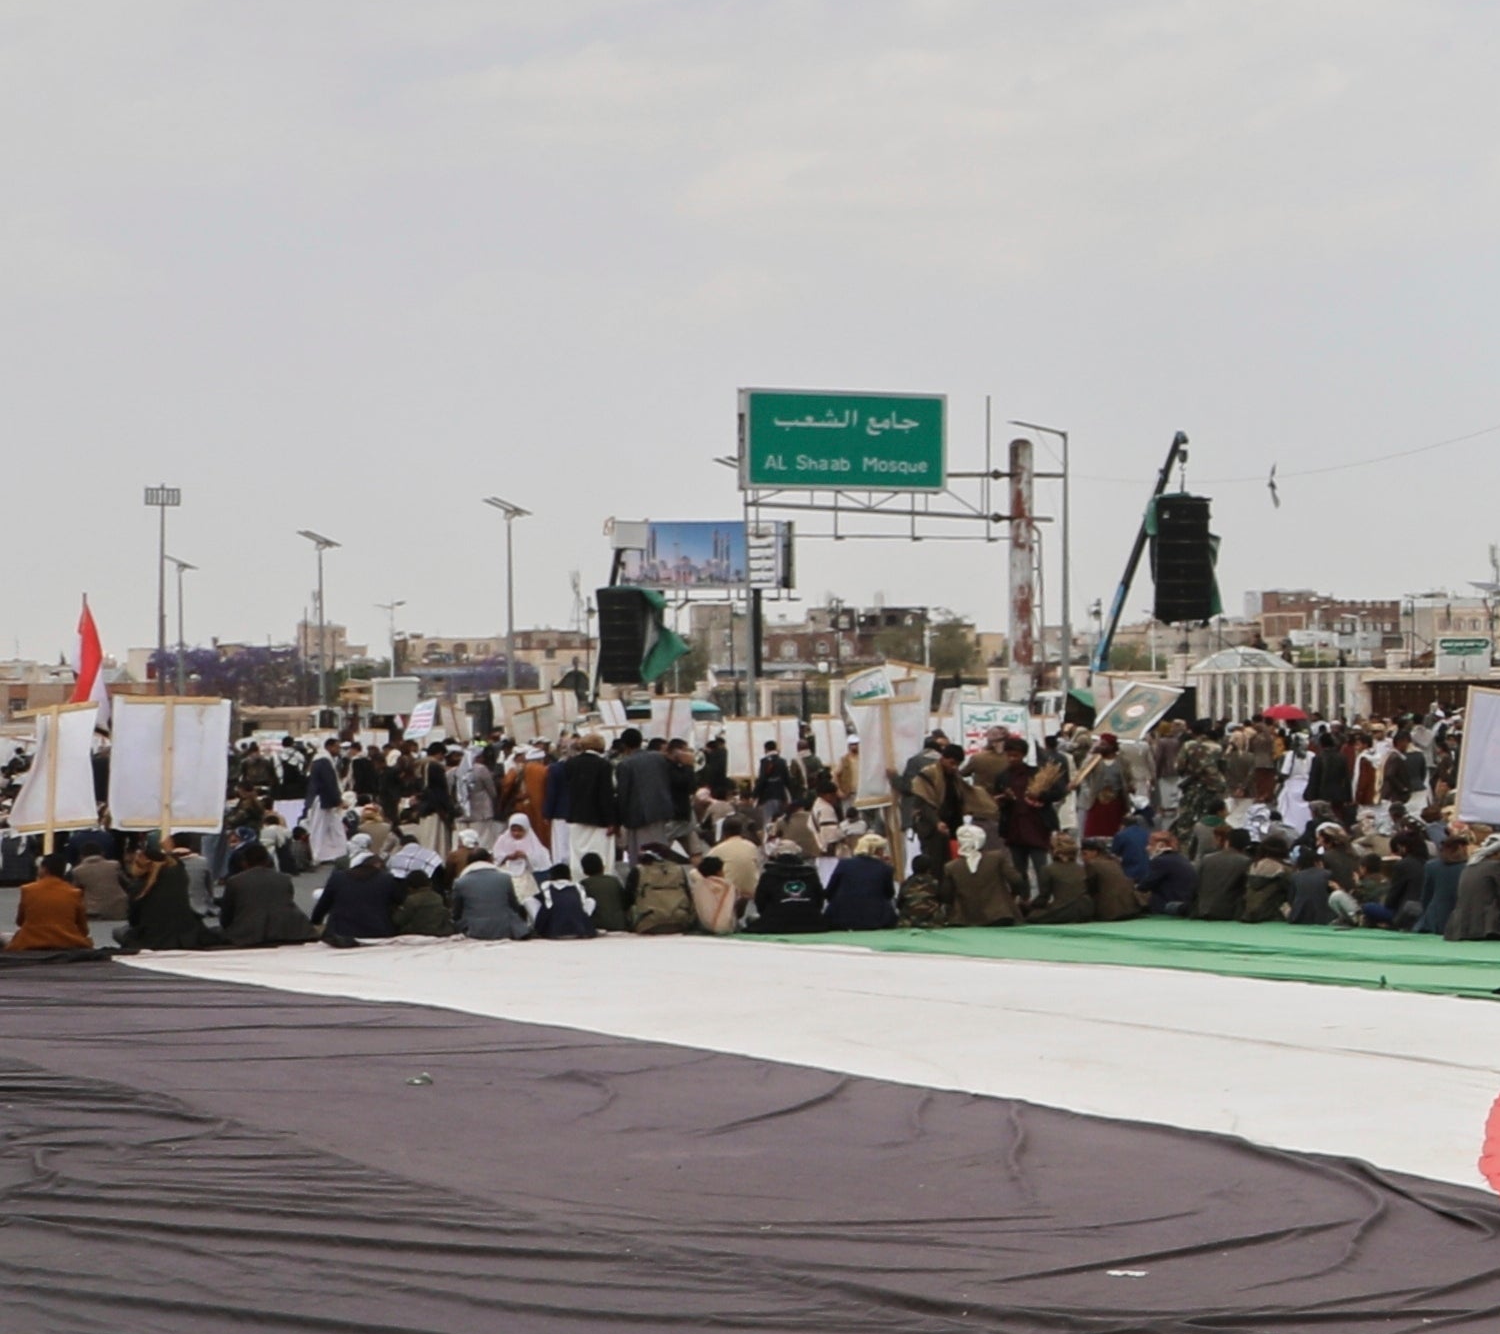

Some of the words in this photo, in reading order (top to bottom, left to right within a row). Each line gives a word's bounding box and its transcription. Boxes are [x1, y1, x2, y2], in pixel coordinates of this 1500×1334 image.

[773, 409, 858, 432] الشعب
[865, 411, 920, 436] جامع
[796, 454, 851, 472] Shaab
[862, 456, 929, 475] Mosque
